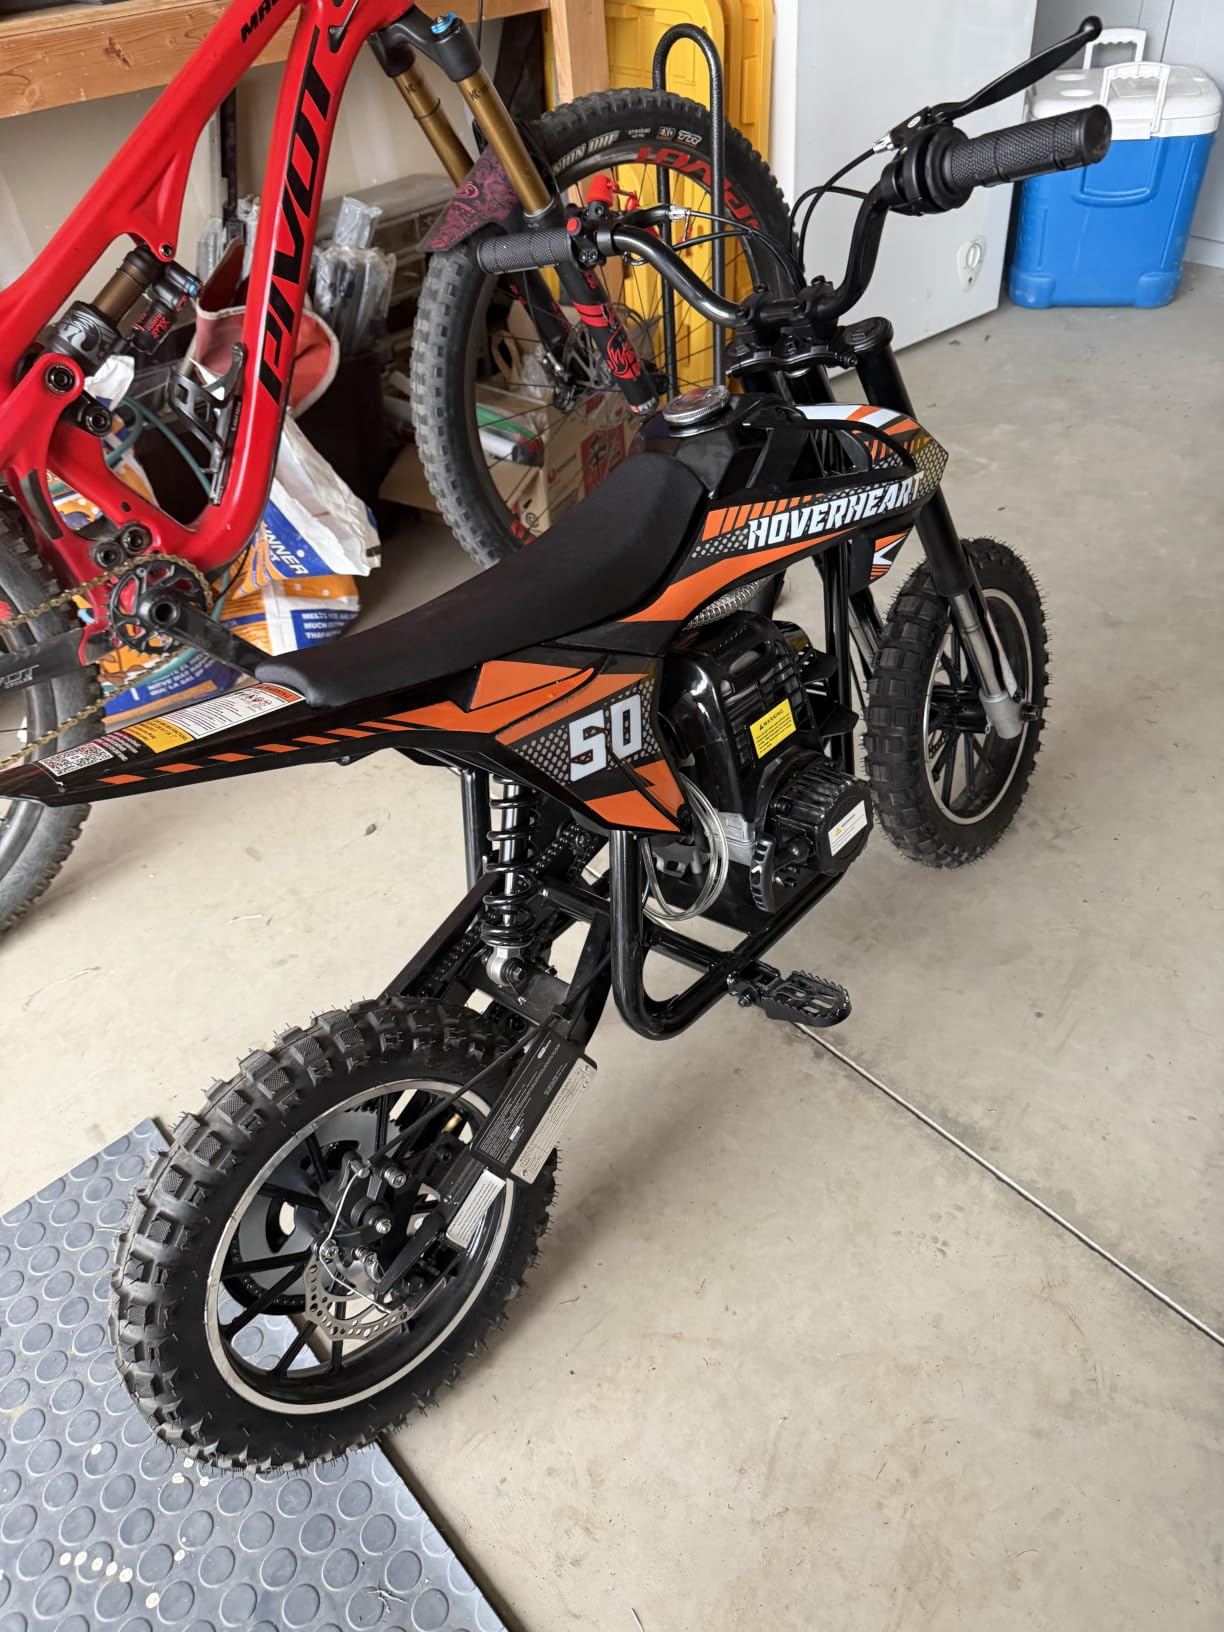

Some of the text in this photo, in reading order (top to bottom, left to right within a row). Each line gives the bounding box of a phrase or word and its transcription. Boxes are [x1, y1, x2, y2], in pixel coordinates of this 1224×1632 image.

[257, 25, 331, 405] PIVOT
[747, 471, 925, 550] HOVERHEART
[568, 694, 642, 782] 50
[763, 709, 784, 726] WARNING
